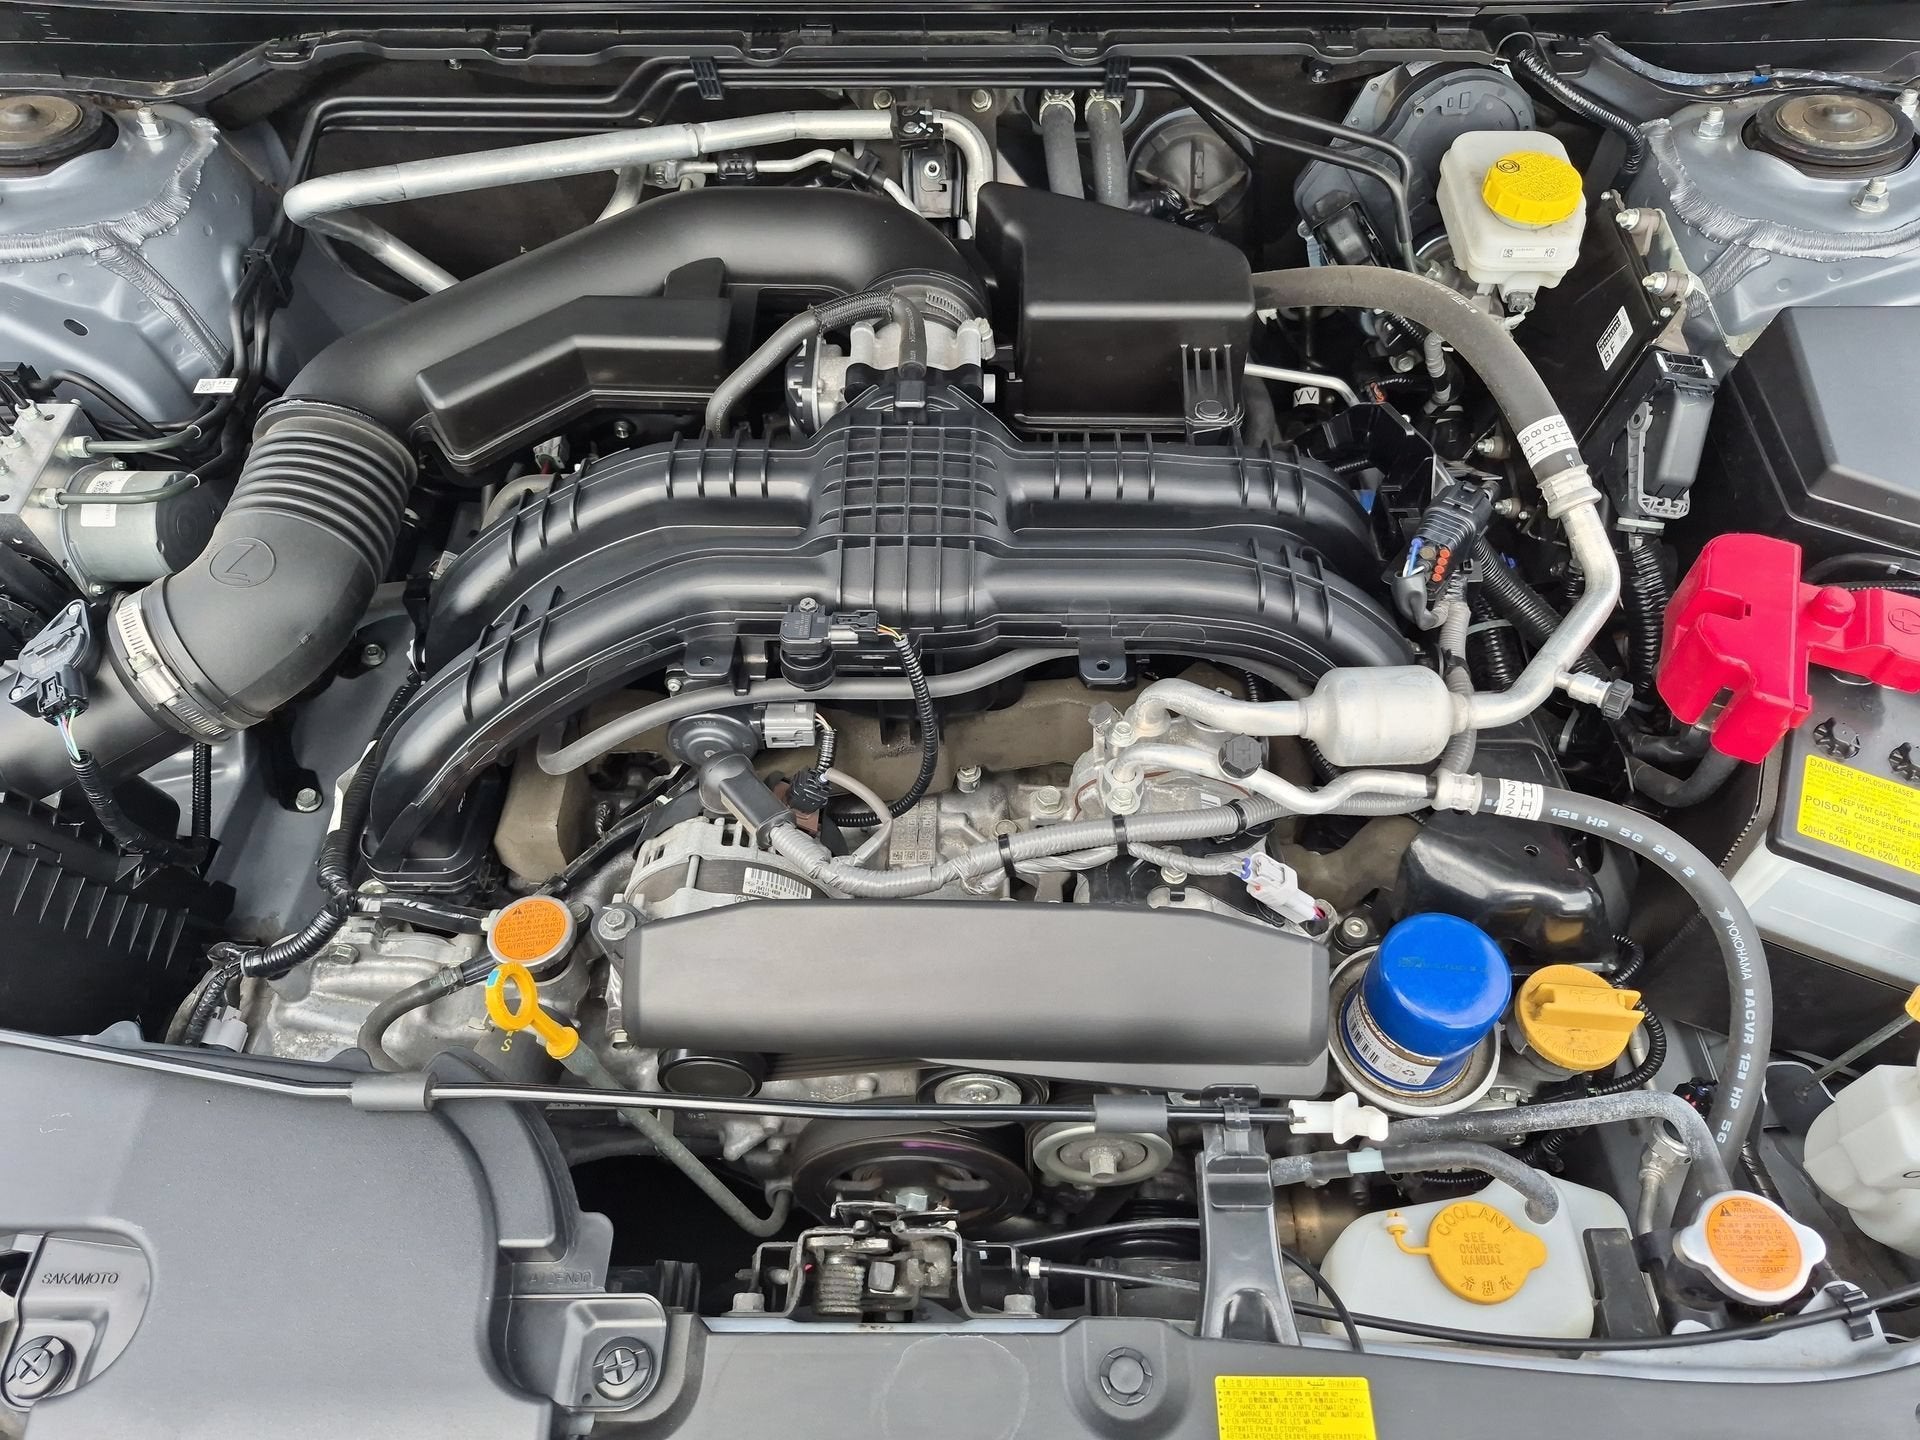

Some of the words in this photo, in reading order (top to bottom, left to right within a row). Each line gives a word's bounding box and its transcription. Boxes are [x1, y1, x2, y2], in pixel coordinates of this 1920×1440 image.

[1603, 342, 1616, 363] BF
[1809, 758, 1855, 779] DANGER
[1804, 795, 1849, 816] POISON
[1585, 815, 1609, 829] HP
[1618, 827, 1645, 843] 5G
[1652, 844, 1678, 863] 23
[1681, 865, 1696, 878] 2
[1855, 841, 1876, 855] CCA
[1725, 922, 1752, 980] YOKOHAMA
[1730, 1085, 1744, 1110] HP
[1436, 1205, 1515, 1236] COOLANT
[1463, 1232, 1486, 1242] SEE
[1461, 1255, 1504, 1266] MANUAL
[42, 1272, 119, 1284] SAKAMOTO
